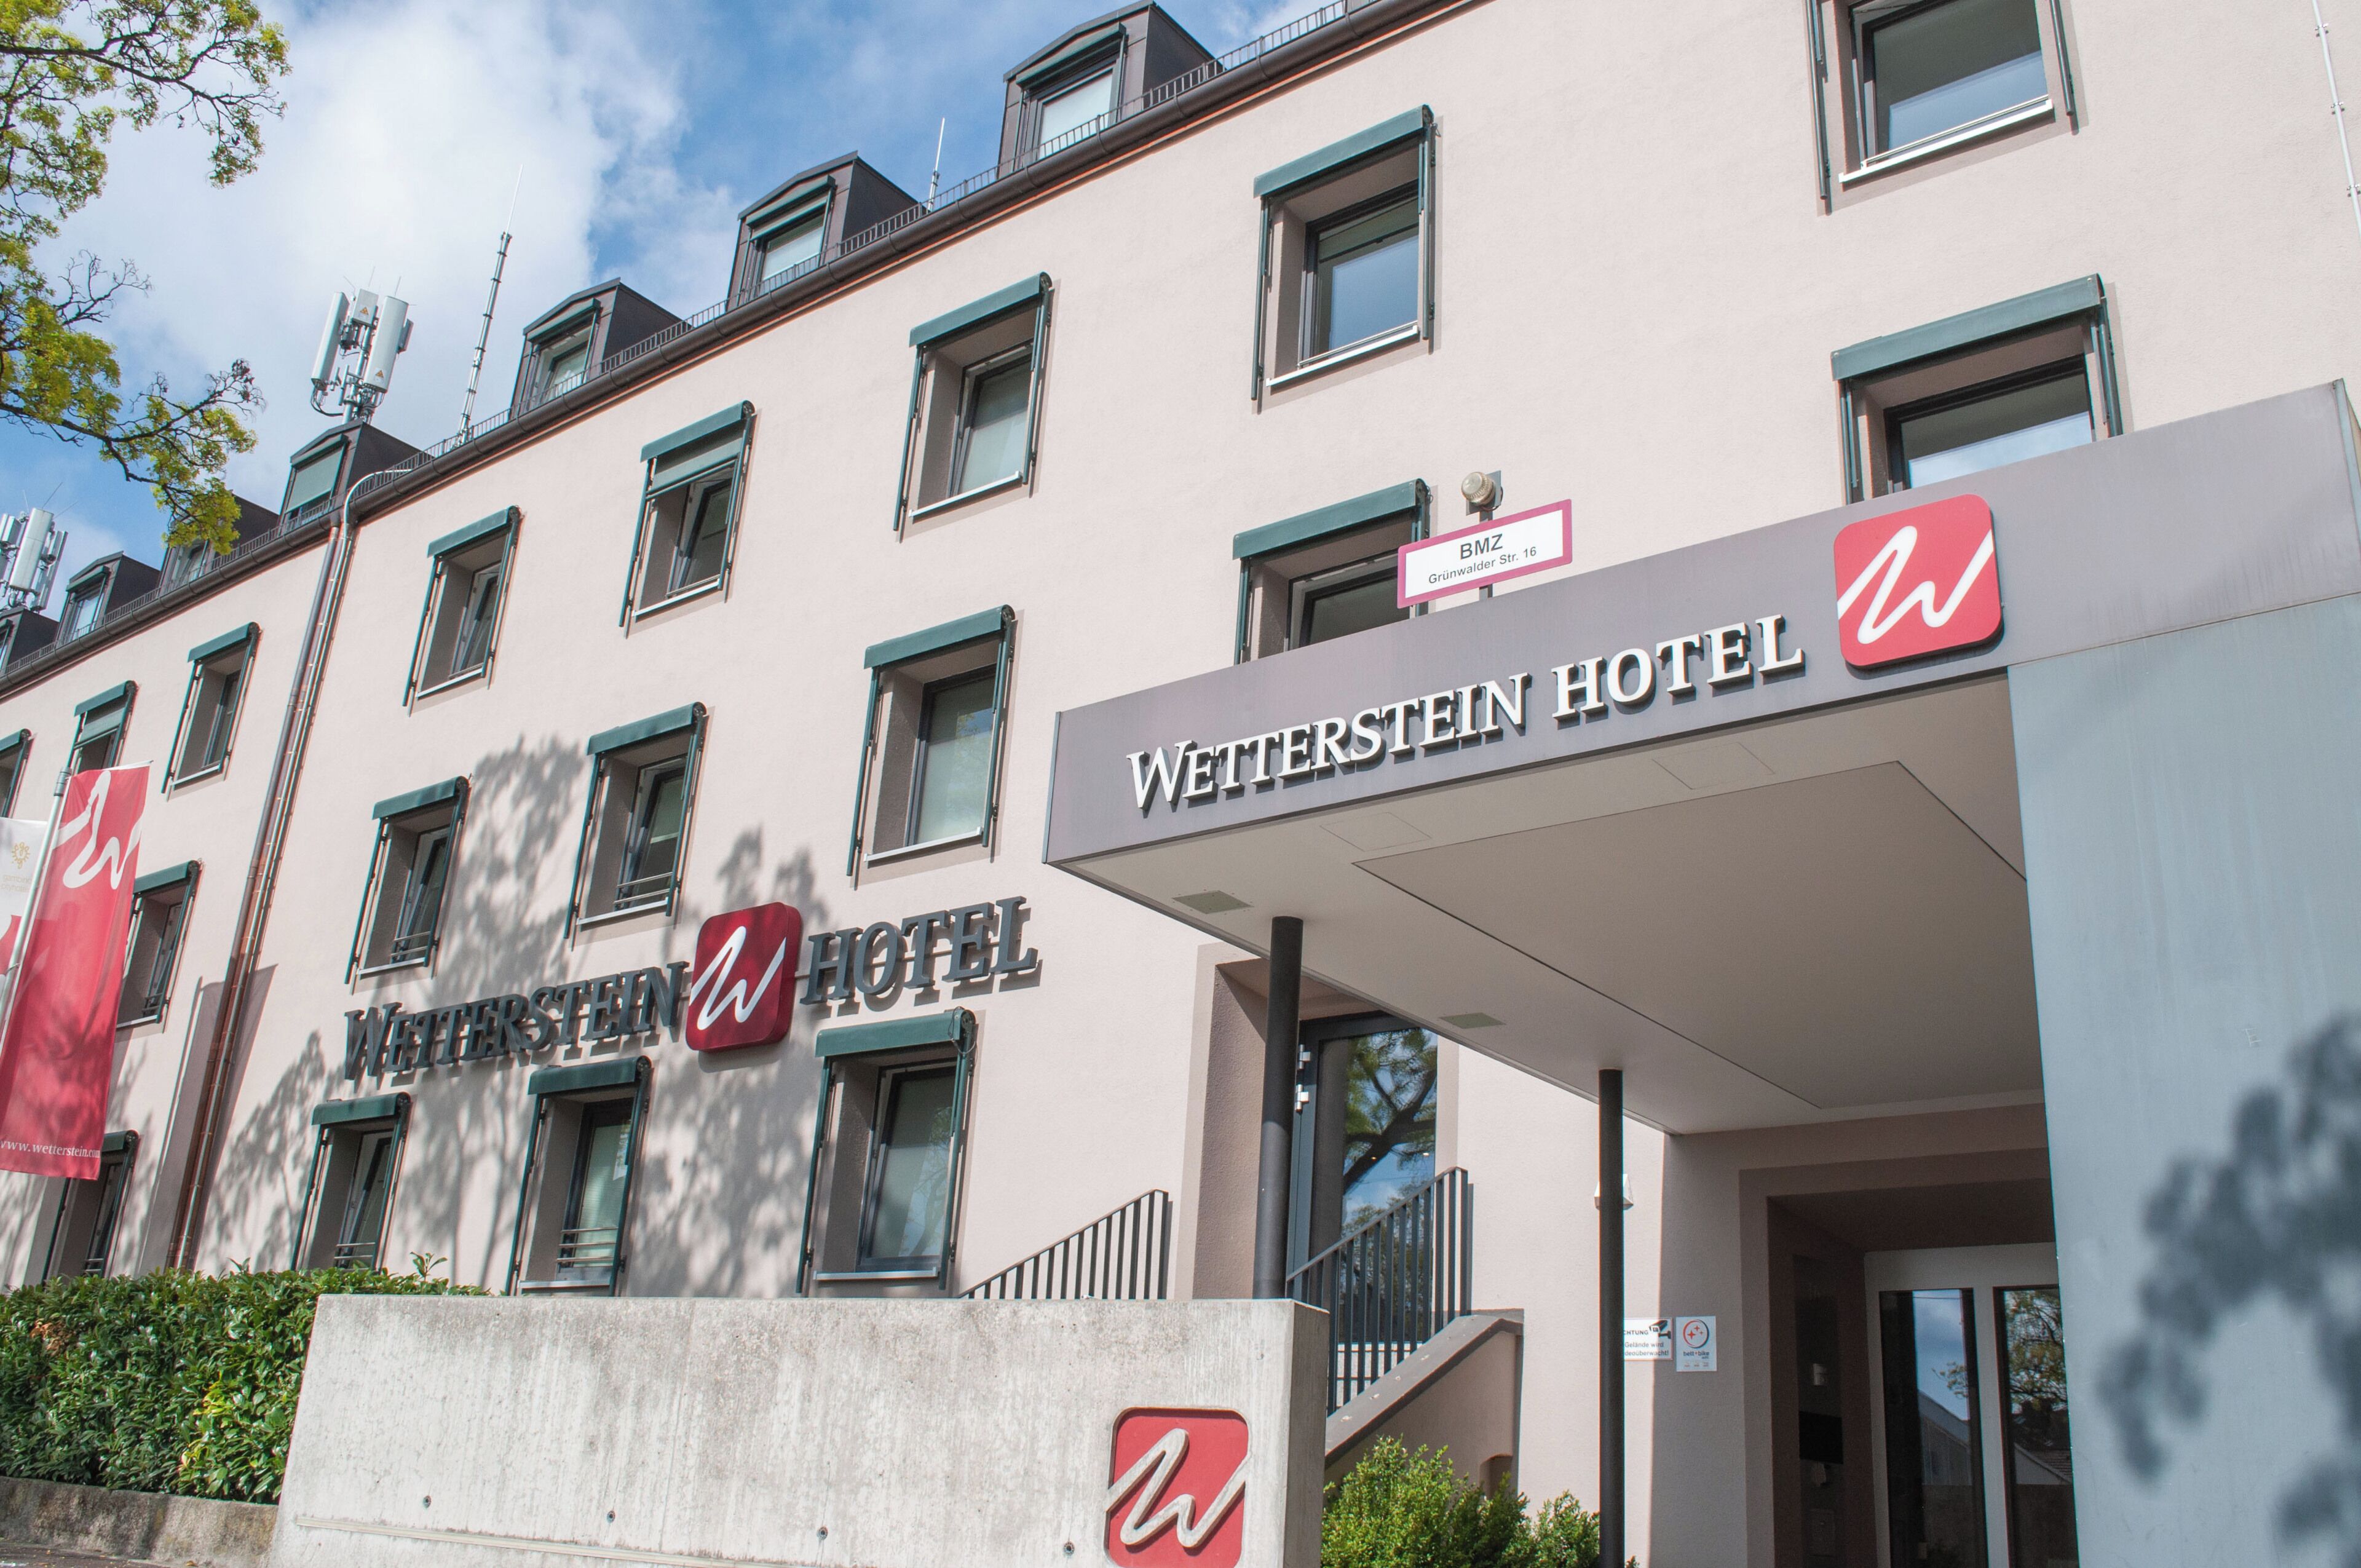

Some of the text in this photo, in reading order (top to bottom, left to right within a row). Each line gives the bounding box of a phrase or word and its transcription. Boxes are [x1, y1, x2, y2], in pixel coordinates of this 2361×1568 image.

[1429, 547, 1537, 584] Grünwalder Str. 16
[1460, 534, 1503, 560] BMZ
[1126, 615, 1805, 810] WETTERSTEIN HOTEL
[344, 960, 690, 1080] WETTERSTEIN
[800, 896, 1038, 1005] HOTEL
